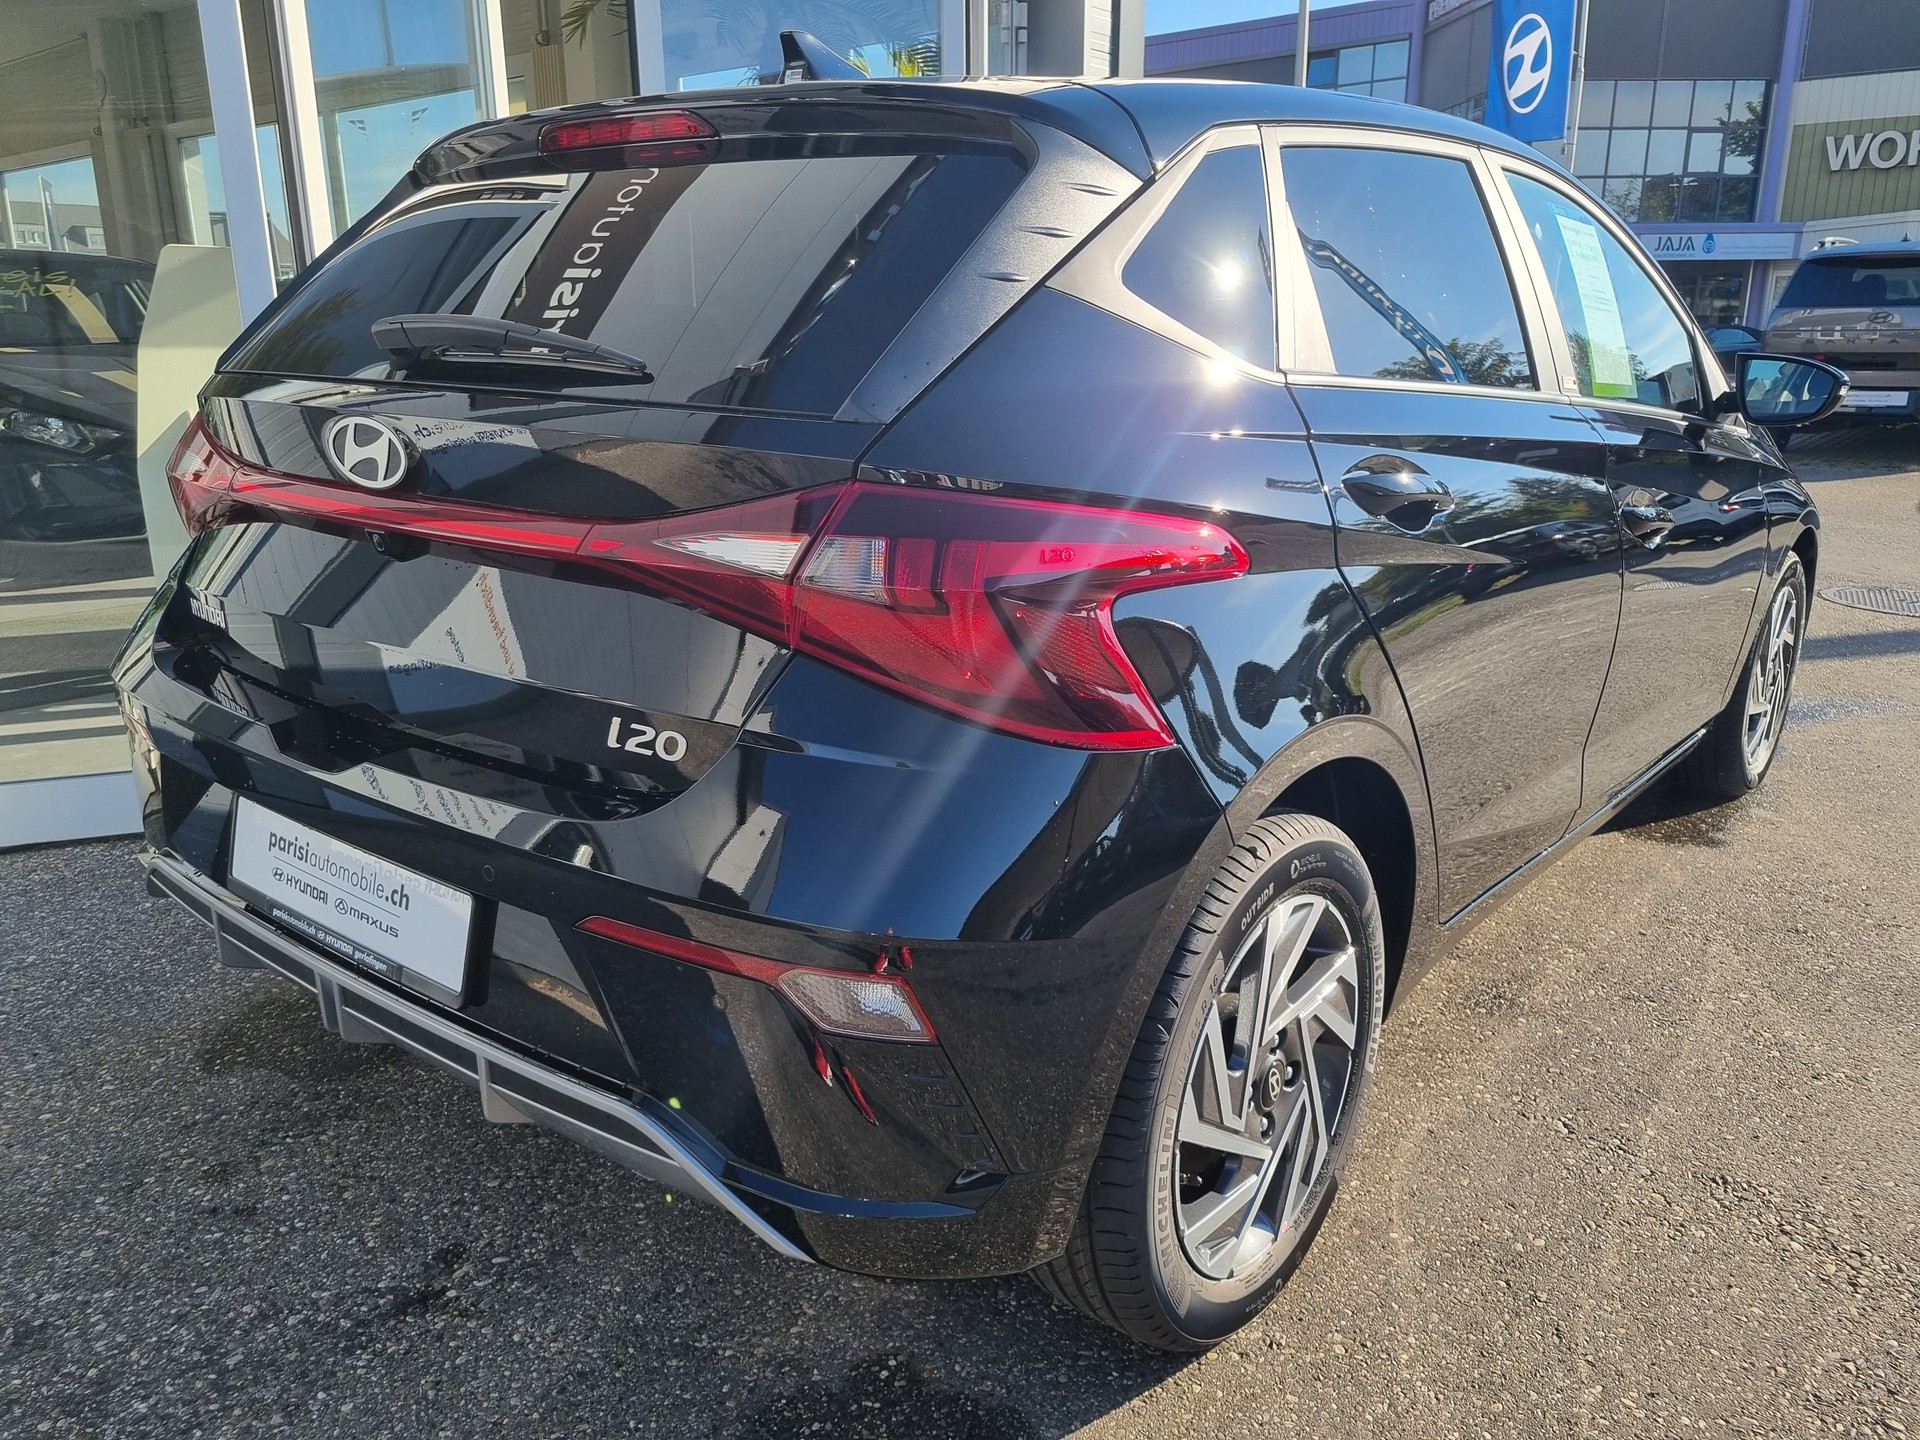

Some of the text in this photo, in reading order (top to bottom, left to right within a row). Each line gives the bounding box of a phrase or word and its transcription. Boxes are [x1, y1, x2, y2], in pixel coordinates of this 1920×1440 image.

[1654, 236, 1695, 251] JAJA
[190, 597, 226, 630] HYUNDAI
[607, 716, 687, 762] i20
[268, 830, 411, 911] parisiautomobile.ch
[286, 872, 400, 938] HYUNDAI MAXUS
[1241, 882, 1275, 931] OUTSIDE
[272, 907, 387, 972] parisiautomobile.ch HYUNDAI gerlafingen
[1366, 944, 1383, 1066] MICHELIN
[1157, 1115, 1175, 1269] MICHELIN
